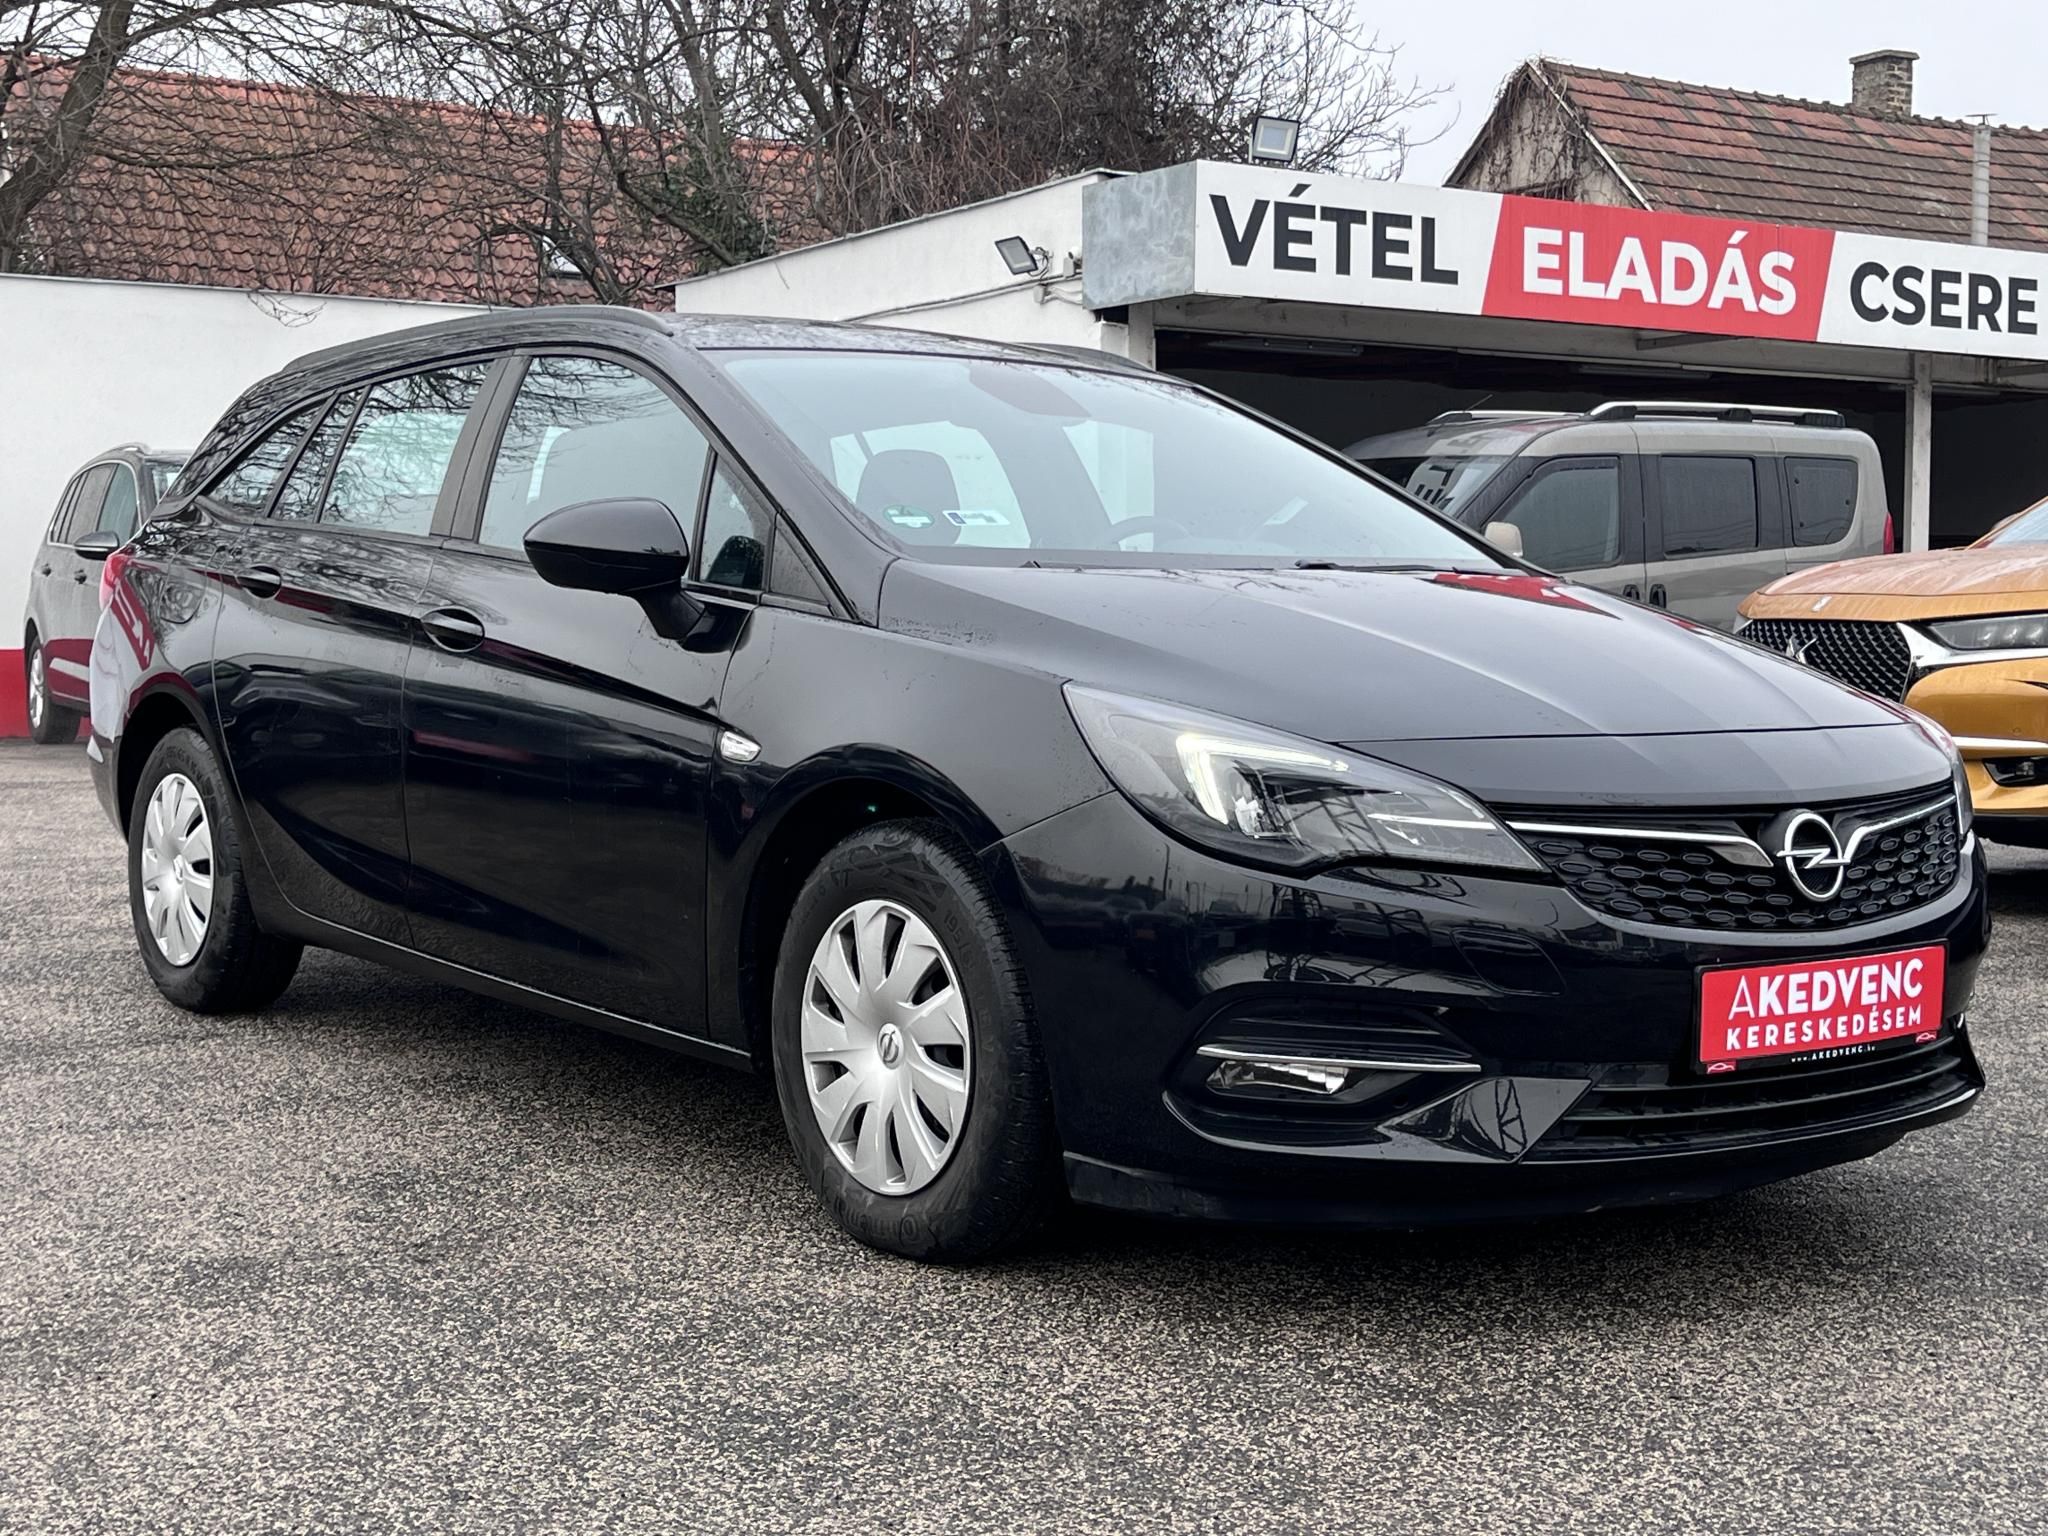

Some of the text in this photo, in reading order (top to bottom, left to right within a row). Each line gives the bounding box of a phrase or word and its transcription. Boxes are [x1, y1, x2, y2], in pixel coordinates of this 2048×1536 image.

[1209, 184, 2039, 335] VÉTEL ELADÁS CSERE
[1726, 1003, 1922, 1051] KERESKEDÉSEM
